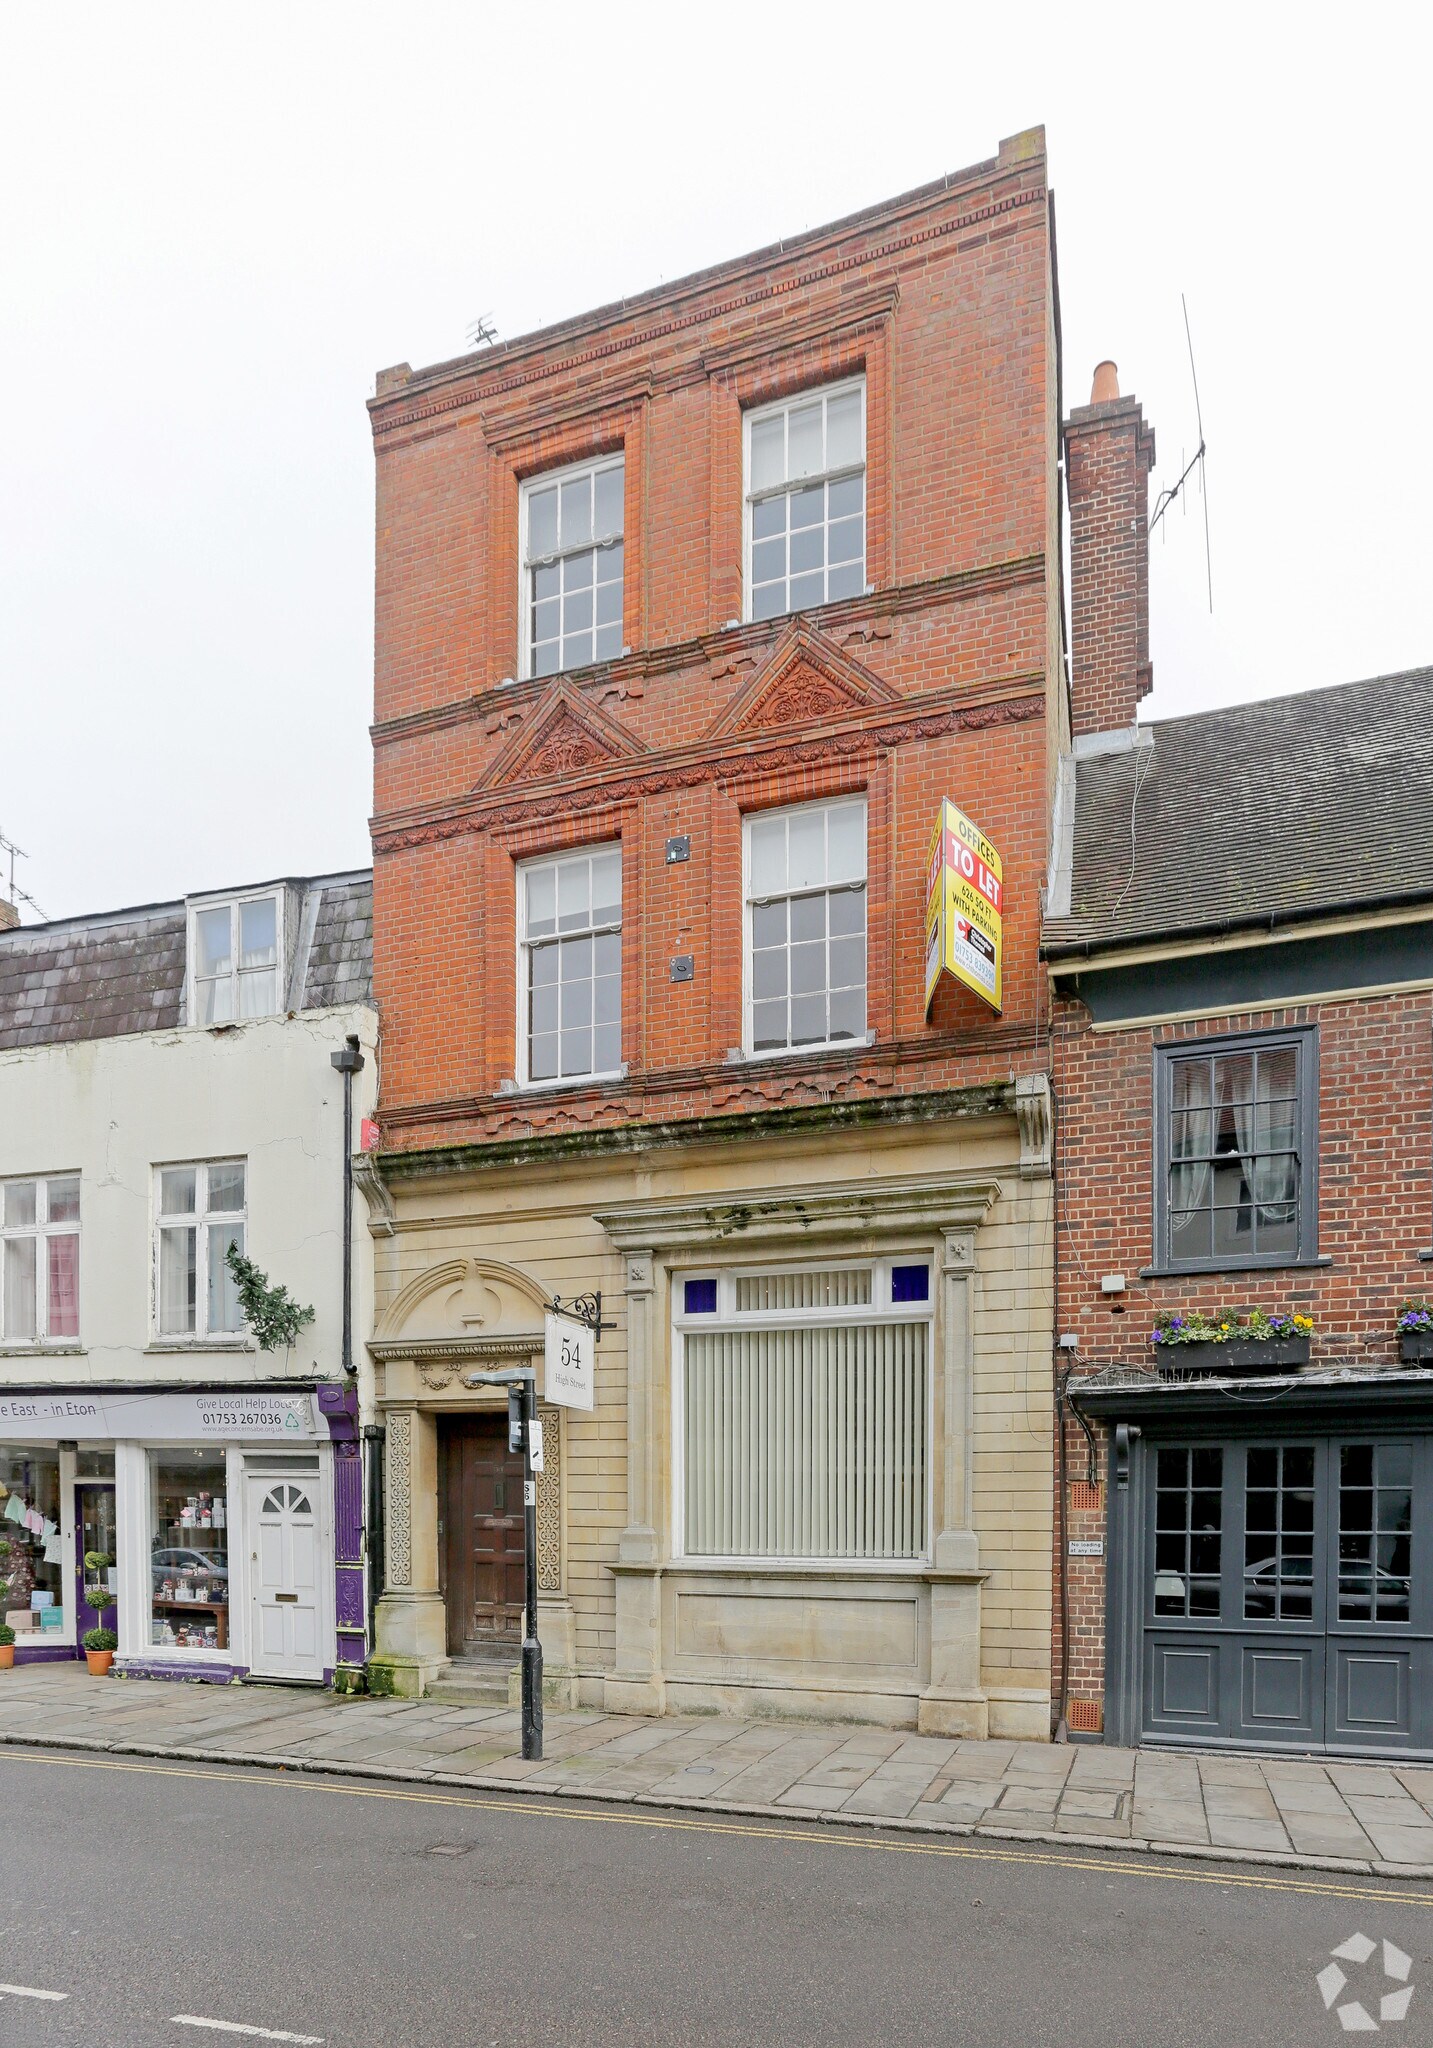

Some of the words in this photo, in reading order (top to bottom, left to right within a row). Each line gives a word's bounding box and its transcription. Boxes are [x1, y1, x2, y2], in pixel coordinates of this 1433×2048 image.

[959, 820, 995, 868] OFFICES
[951, 837, 974, 878] TO
[978, 862, 1000, 906] LET
[952, 890, 970, 915] WITH
[971, 908, 998, 942] PARKING
[961, 885, 974, 903] 626
[975, 896, 984, 912] SQ
[985, 905, 992, 920] FT
[955, 941, 973, 964] 01753
[561, 1337, 581, 1369] 54
[555, 1372, 570, 1387] High
[569, 1376, 587, 1390] Street
[11, 1402, 38, 1417] East
[50, 1401, 64, 1416] in
[66, 1401, 97, 1417] Eton
[196, 1398, 217, 1409] Give
[219, 1398, 244, 1409] Local
[245, 1398, 267, 1411] Help
[202, 1413, 238, 1425] 01753
[240, 1413, 282, 1425] 267036
